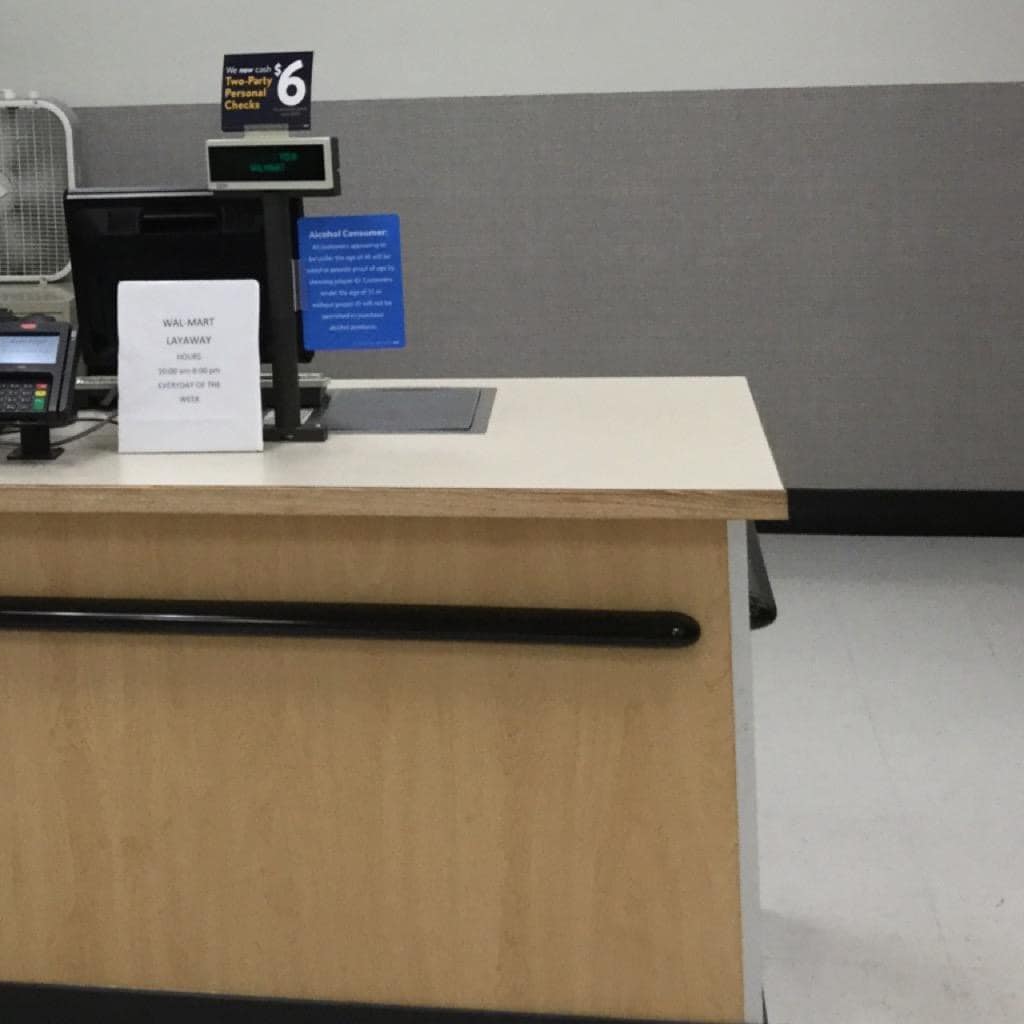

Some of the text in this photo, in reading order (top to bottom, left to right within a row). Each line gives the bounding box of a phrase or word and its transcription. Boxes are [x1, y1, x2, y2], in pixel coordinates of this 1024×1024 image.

[255, 65, 272, 74] cash
[225, 76, 273, 88] Two-Party
[224, 88, 267, 98] Personal
[224, 100, 261, 110] Checks
[309, 229, 341, 240] Alcohol
[166, 335, 212, 346] LAYAWAY
